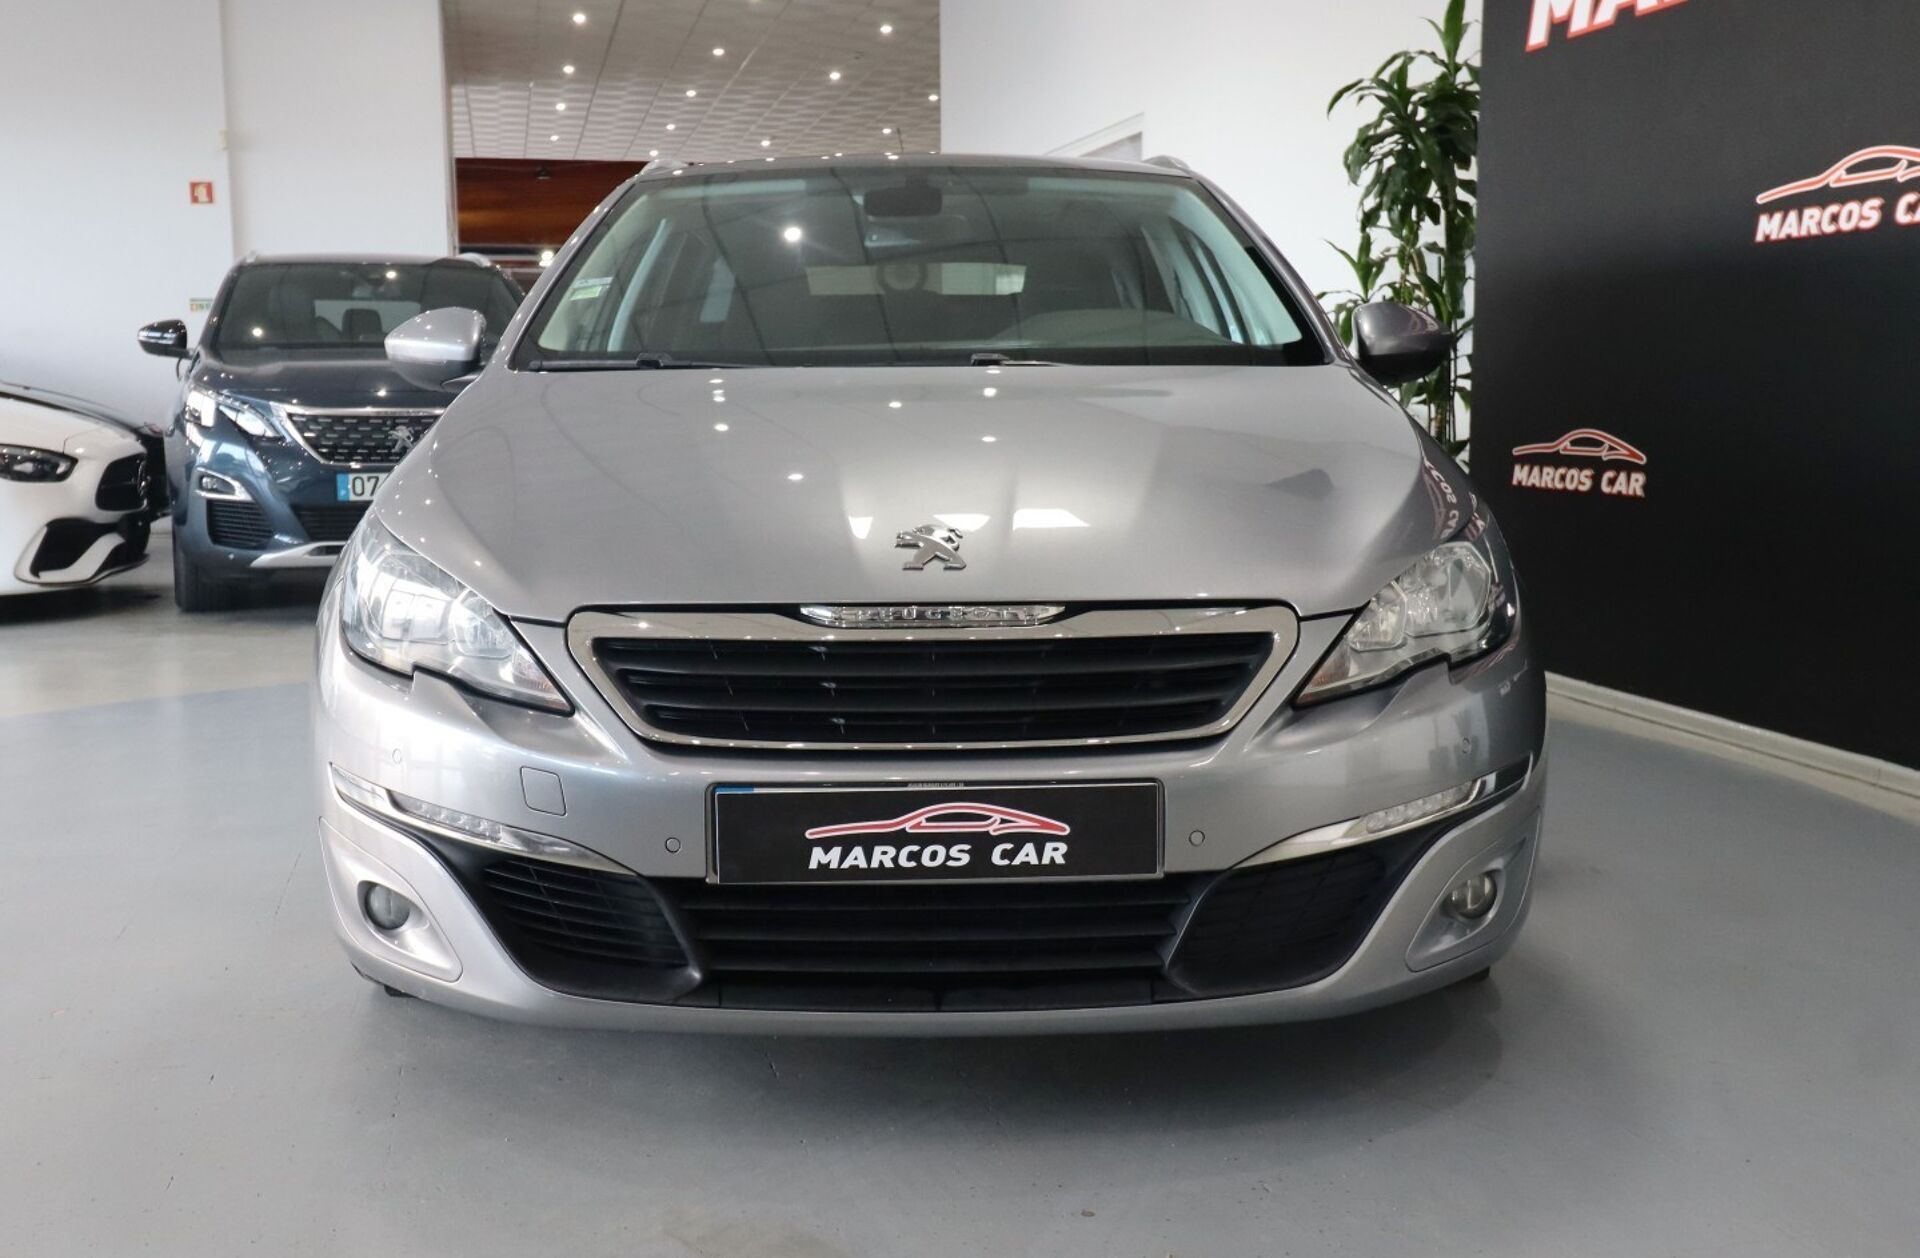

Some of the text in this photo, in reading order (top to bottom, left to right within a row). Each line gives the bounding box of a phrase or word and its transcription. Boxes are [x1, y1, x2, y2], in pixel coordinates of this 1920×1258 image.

[1754, 197, 1885, 243] MARCOS
[1511, 464, 1646, 498] MARCOS CAR
[808, 841, 1068, 870] MARCOS CAR
